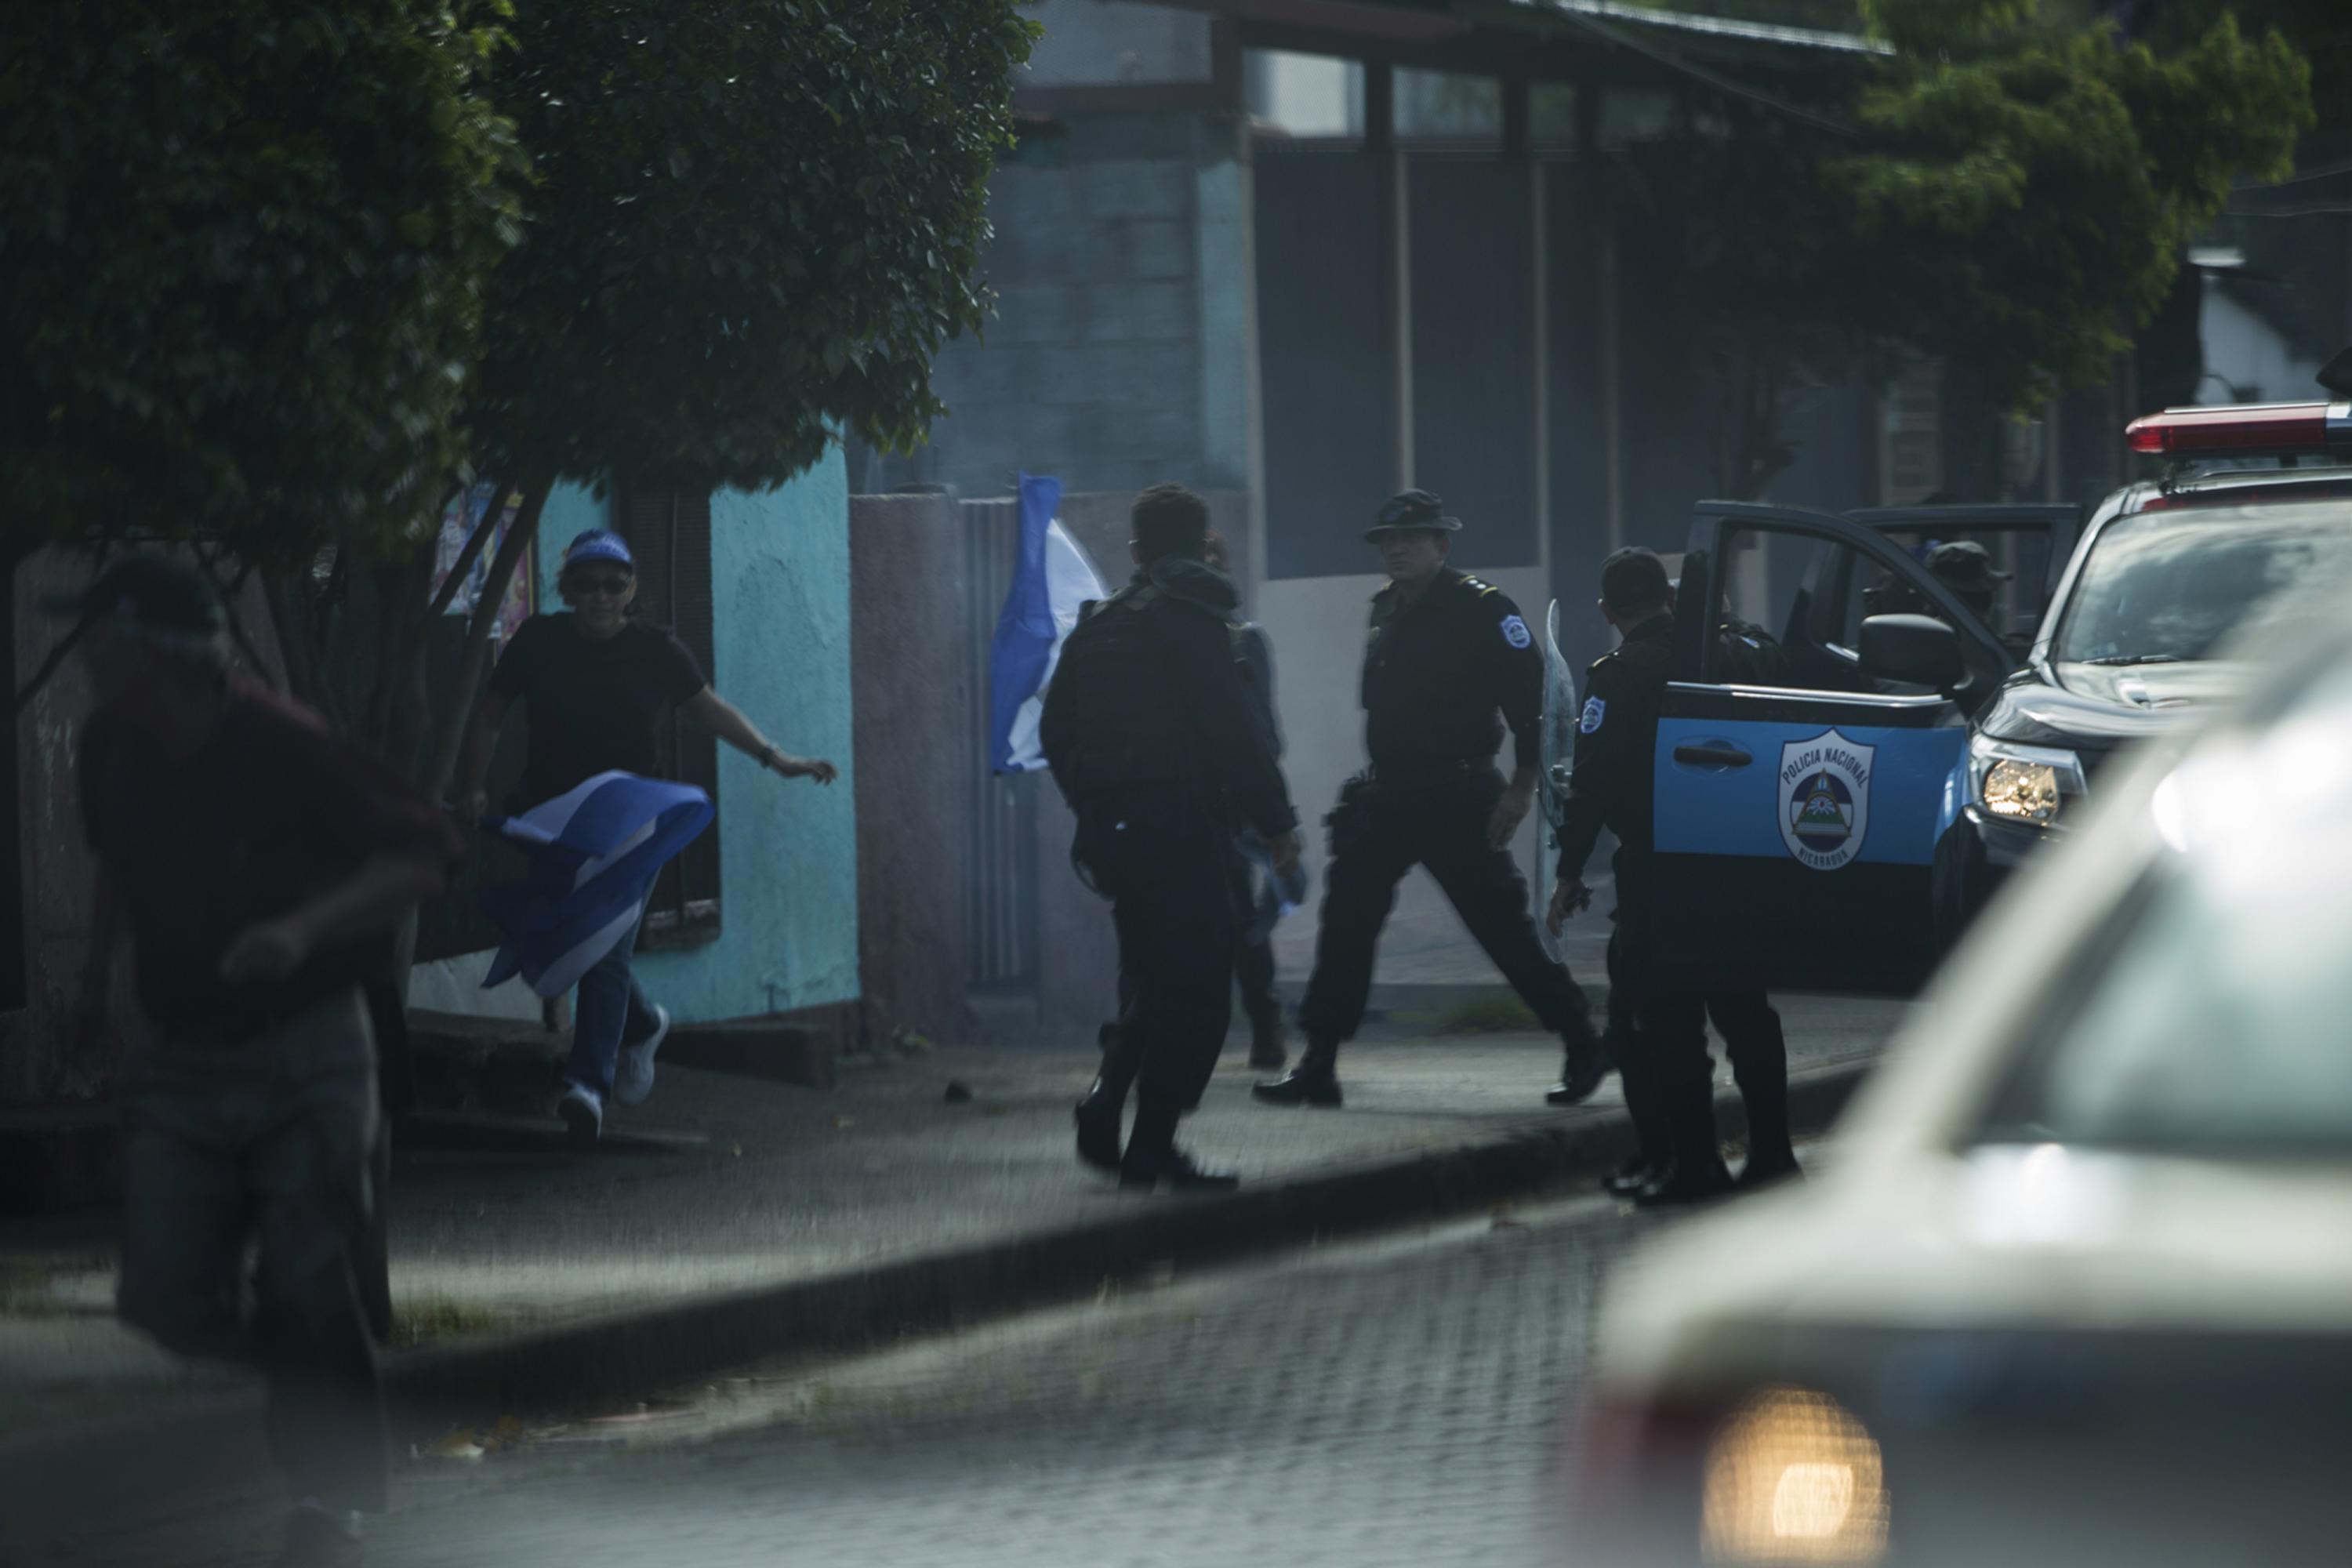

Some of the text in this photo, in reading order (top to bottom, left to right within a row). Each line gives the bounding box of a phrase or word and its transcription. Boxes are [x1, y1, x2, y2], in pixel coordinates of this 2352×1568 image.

[1782, 748, 1868, 789] POLICIA NACIONAL
[1798, 848, 1849, 866] NICARAGUA
